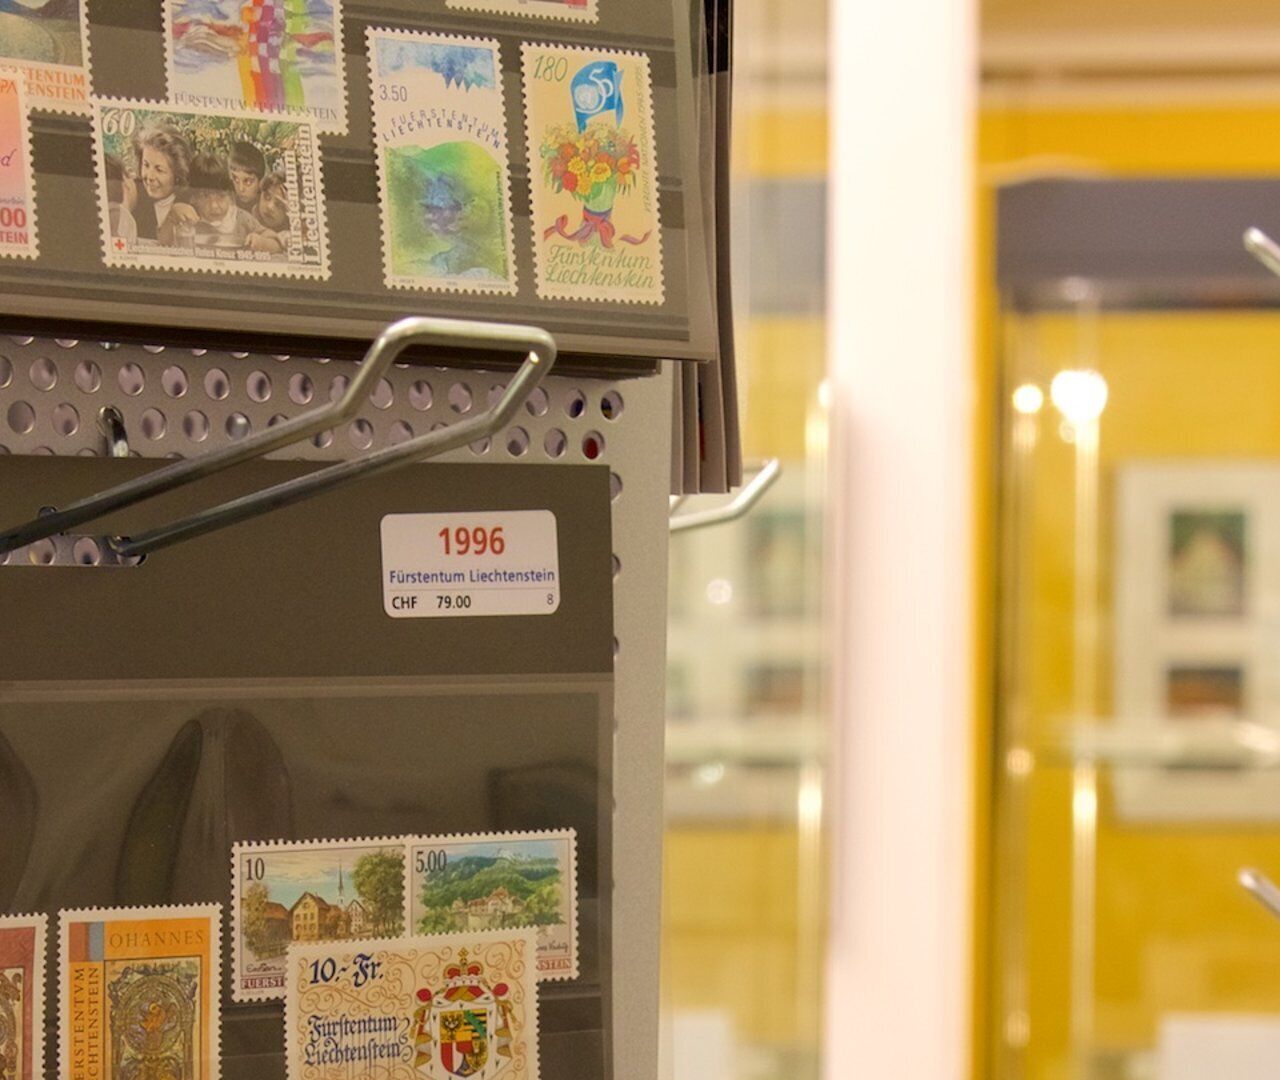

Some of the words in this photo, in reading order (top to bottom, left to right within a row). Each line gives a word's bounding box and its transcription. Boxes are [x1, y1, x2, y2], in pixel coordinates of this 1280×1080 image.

[379, 84, 407, 101] 3.50
[103, 109, 135, 135] 60
[382, 118, 501, 150] LIECHTENSTEIN
[391, 108, 499, 138] FUERSTENTUM
[283, 150, 302, 262] Fürstentum
[296, 125, 321, 264] Liechtenstein
[547, 245, 653, 270] Fürstentum
[544, 263, 655, 289] Liechtenstein
[438, 526, 506, 556] 1996
[389, 570, 465, 584] Fürstentum
[470, 568, 555, 582] Liechtenstein
[392, 596, 417, 609] CHF
[436, 595, 471, 609] 79.00
[245, 858, 265, 881] 10
[415, 849, 448, 873] 5.00
